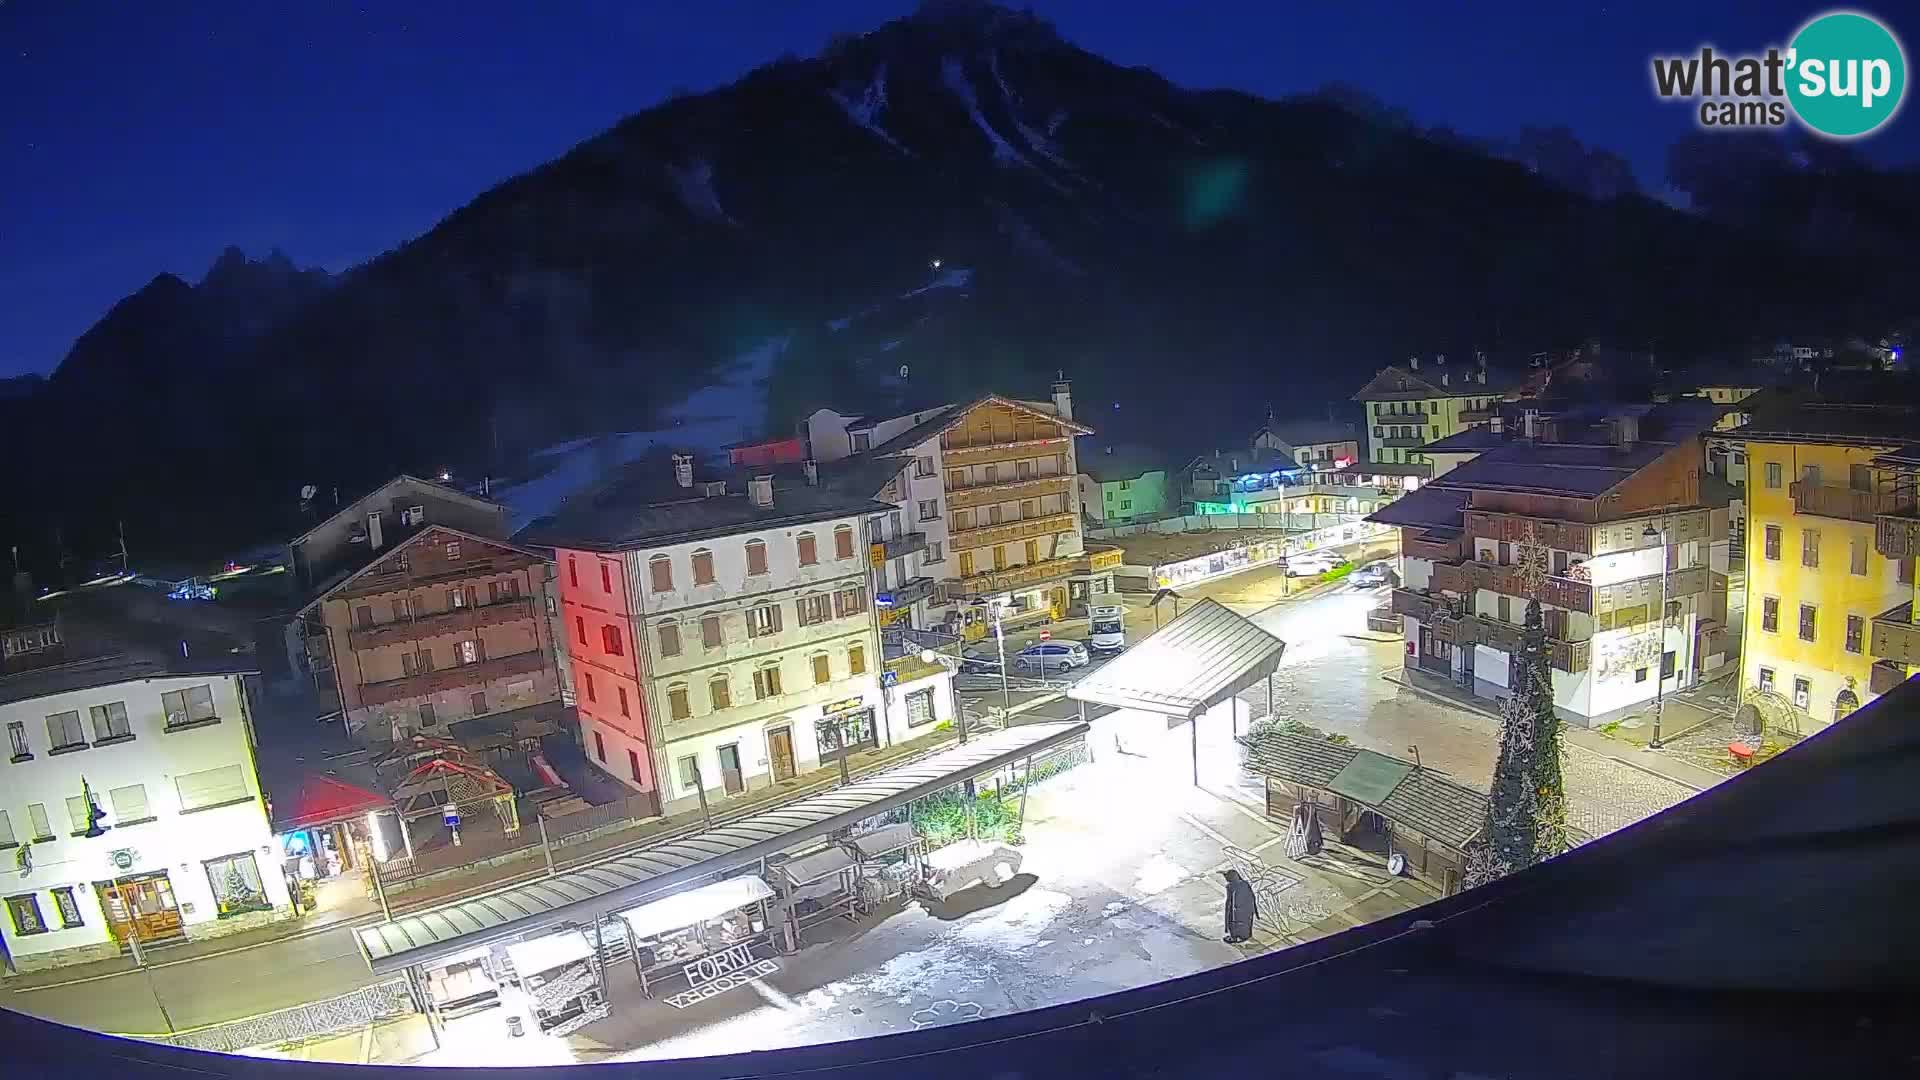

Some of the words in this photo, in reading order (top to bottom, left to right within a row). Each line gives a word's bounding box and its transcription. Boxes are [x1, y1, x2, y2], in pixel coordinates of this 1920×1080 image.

[683, 941, 754, 988] FORNI
[751, 959, 780, 979] DI
[663, 971, 750, 1009] SOPRA
